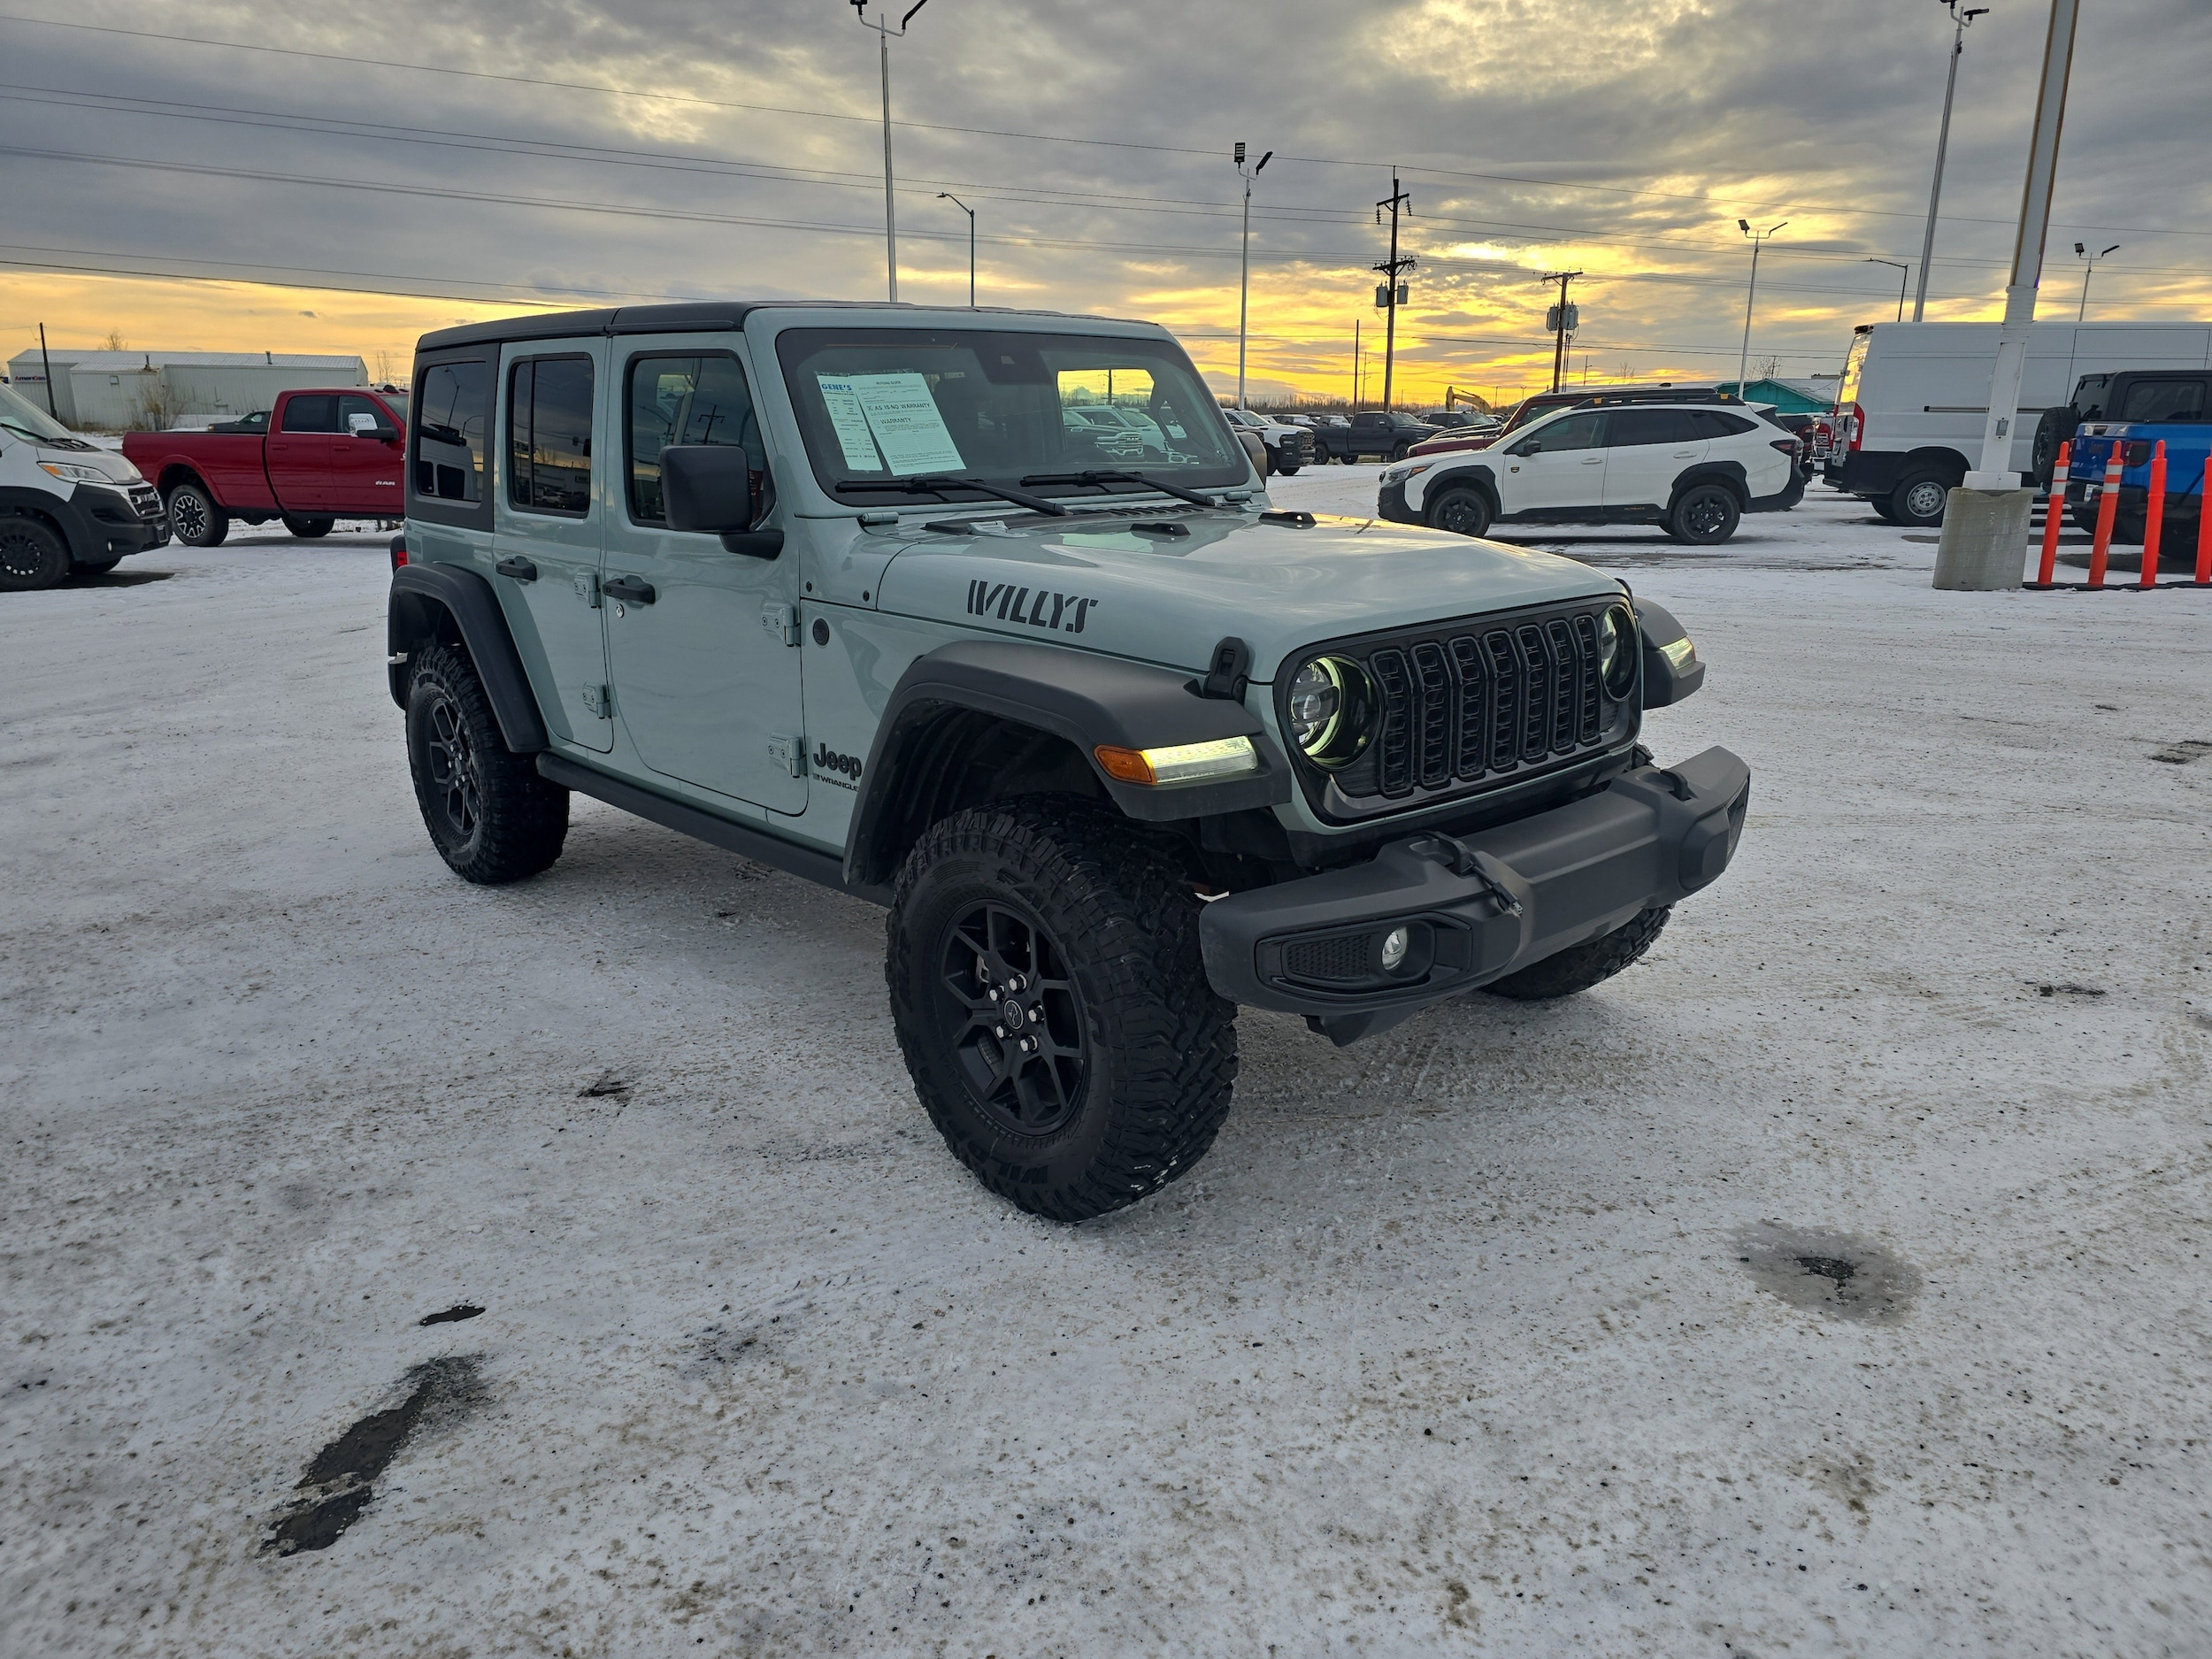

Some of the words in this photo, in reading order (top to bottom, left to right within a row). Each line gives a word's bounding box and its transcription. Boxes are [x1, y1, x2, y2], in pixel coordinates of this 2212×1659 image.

[967, 580, 1099, 634] WILLYS
[813, 742, 862, 781] Jeep
[820, 774, 860, 793] WRANGLE
